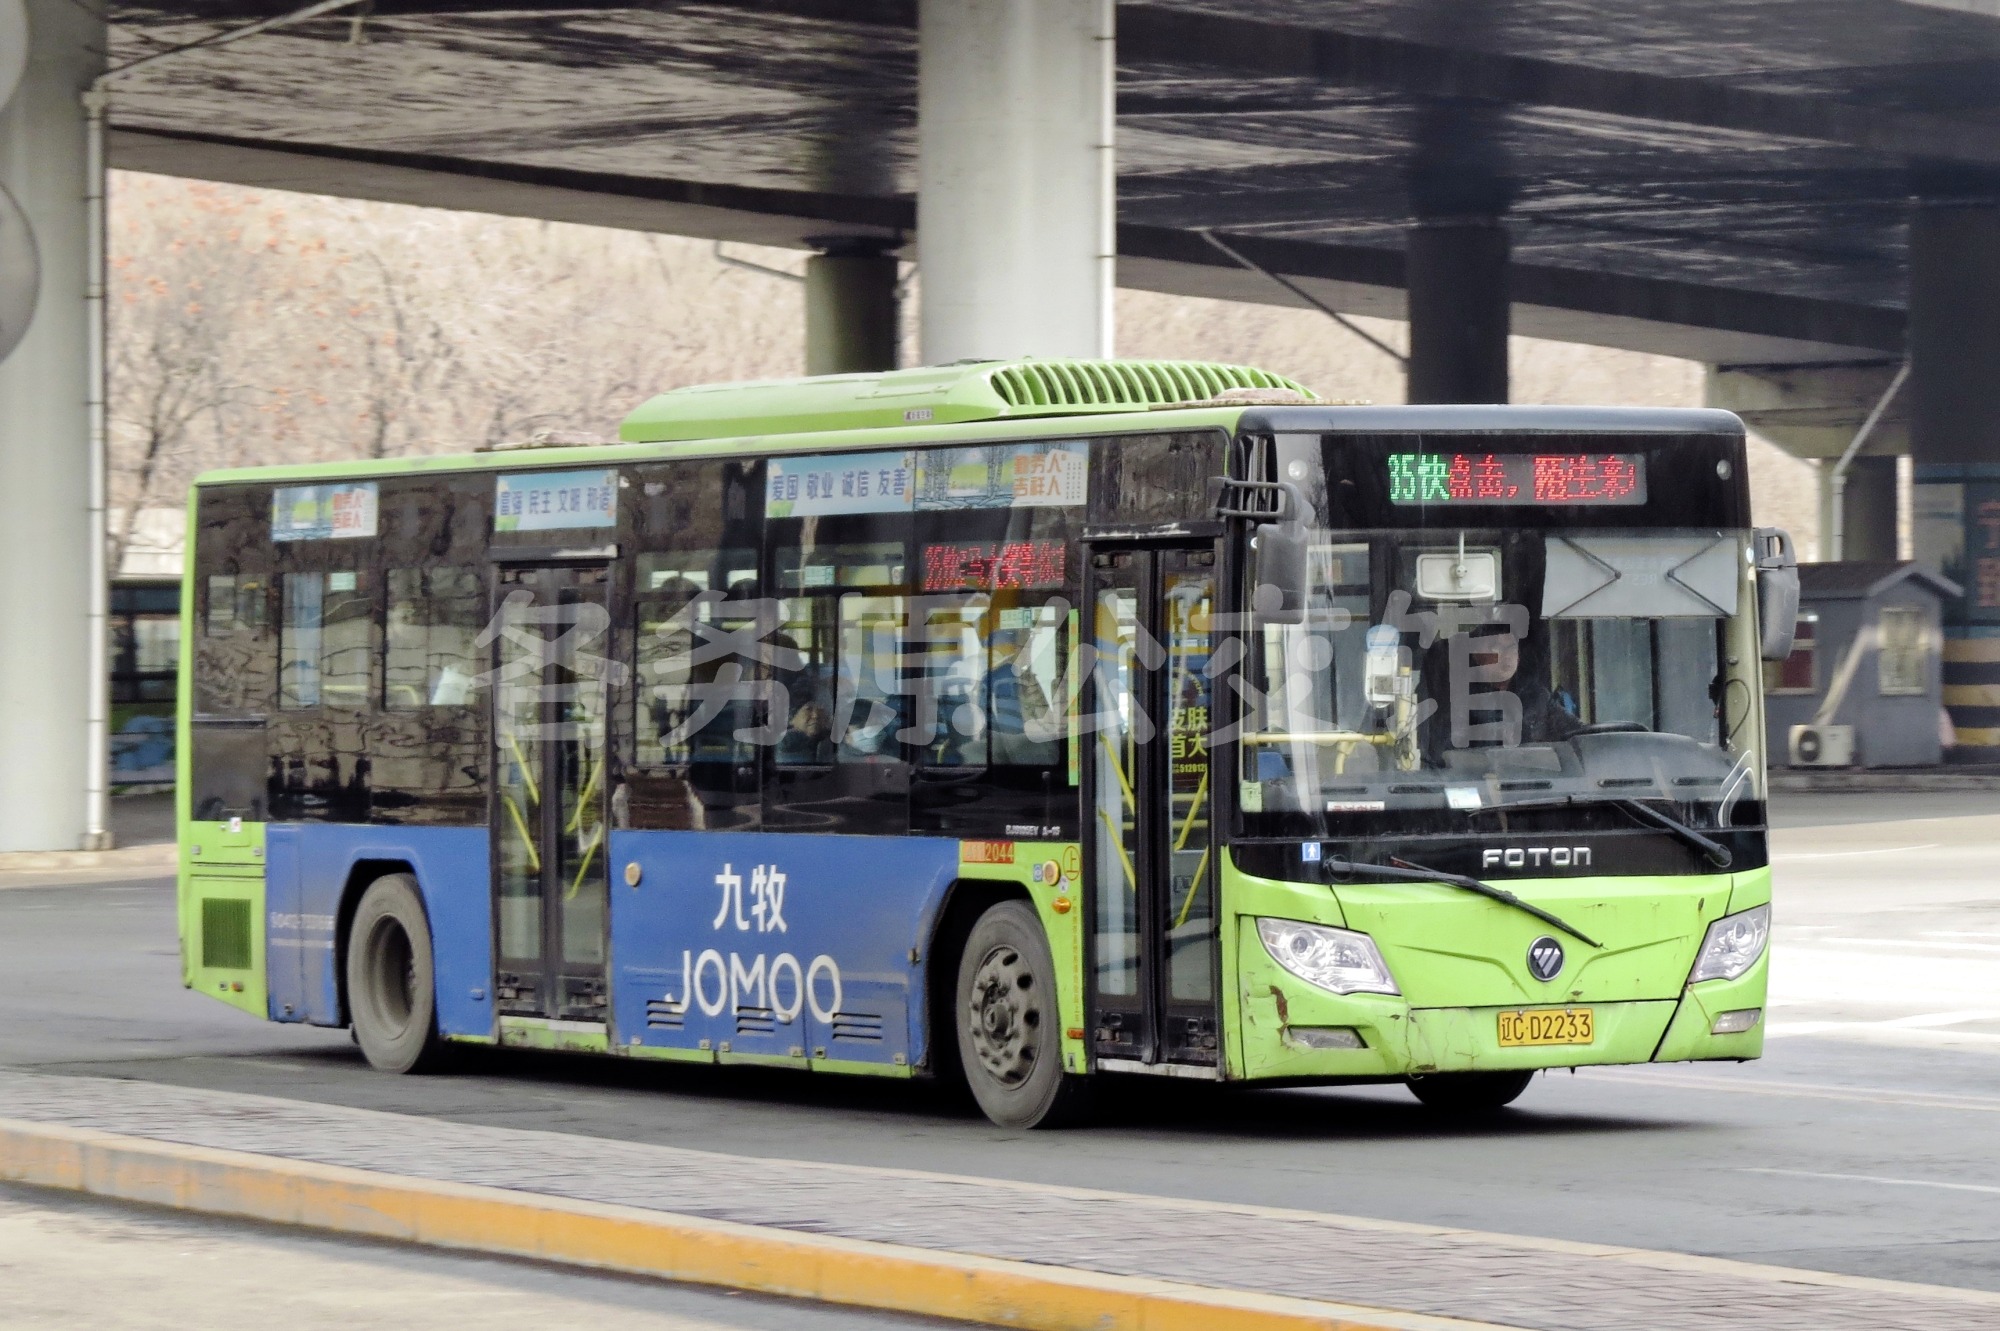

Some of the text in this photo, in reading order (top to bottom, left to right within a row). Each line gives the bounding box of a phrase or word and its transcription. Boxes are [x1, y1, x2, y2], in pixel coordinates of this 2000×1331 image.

[773, 468, 906, 500] 爱国 敬业 诚信 友善
[985, 843, 1014, 862] 2044
[1483, 847, 1592, 868] FOTON
[713, 863, 787, 933] 九牧
[664, 949, 842, 1023] JOMOO
